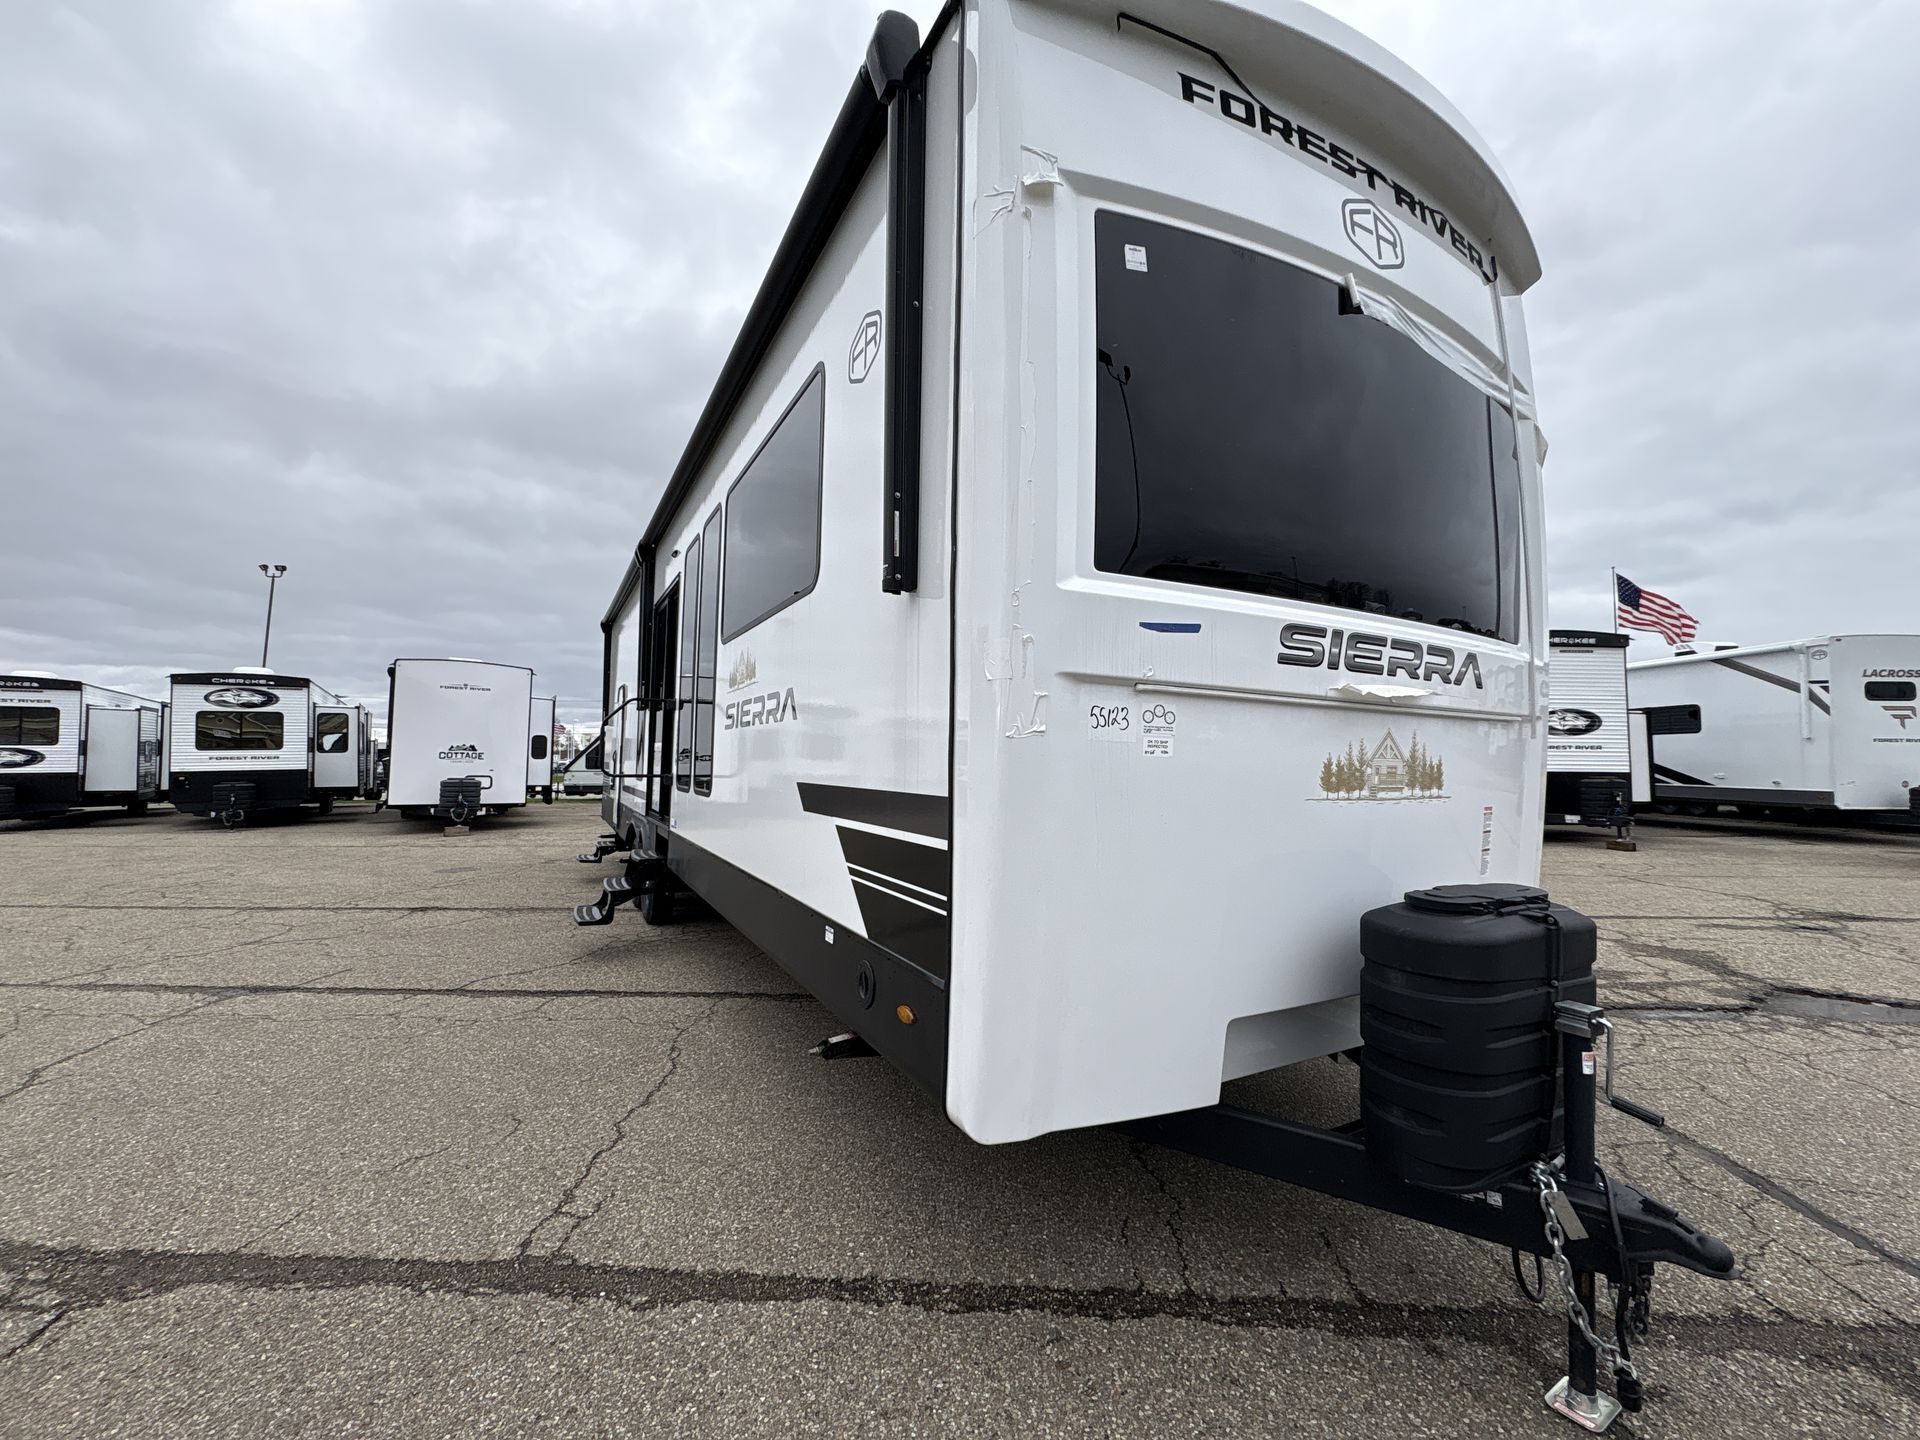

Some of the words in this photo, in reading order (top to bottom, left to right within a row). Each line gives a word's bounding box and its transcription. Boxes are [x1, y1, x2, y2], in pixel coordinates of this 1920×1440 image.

[1177, 71, 1386, 192] FOREST
[1391, 178, 1484, 270] RIVER
[1277, 622, 1484, 690] SIERRA
[724, 687, 798, 731] SIERRA
[1090, 704, 1130, 731] 55123
[438, 751, 485, 761] COTTAGE
